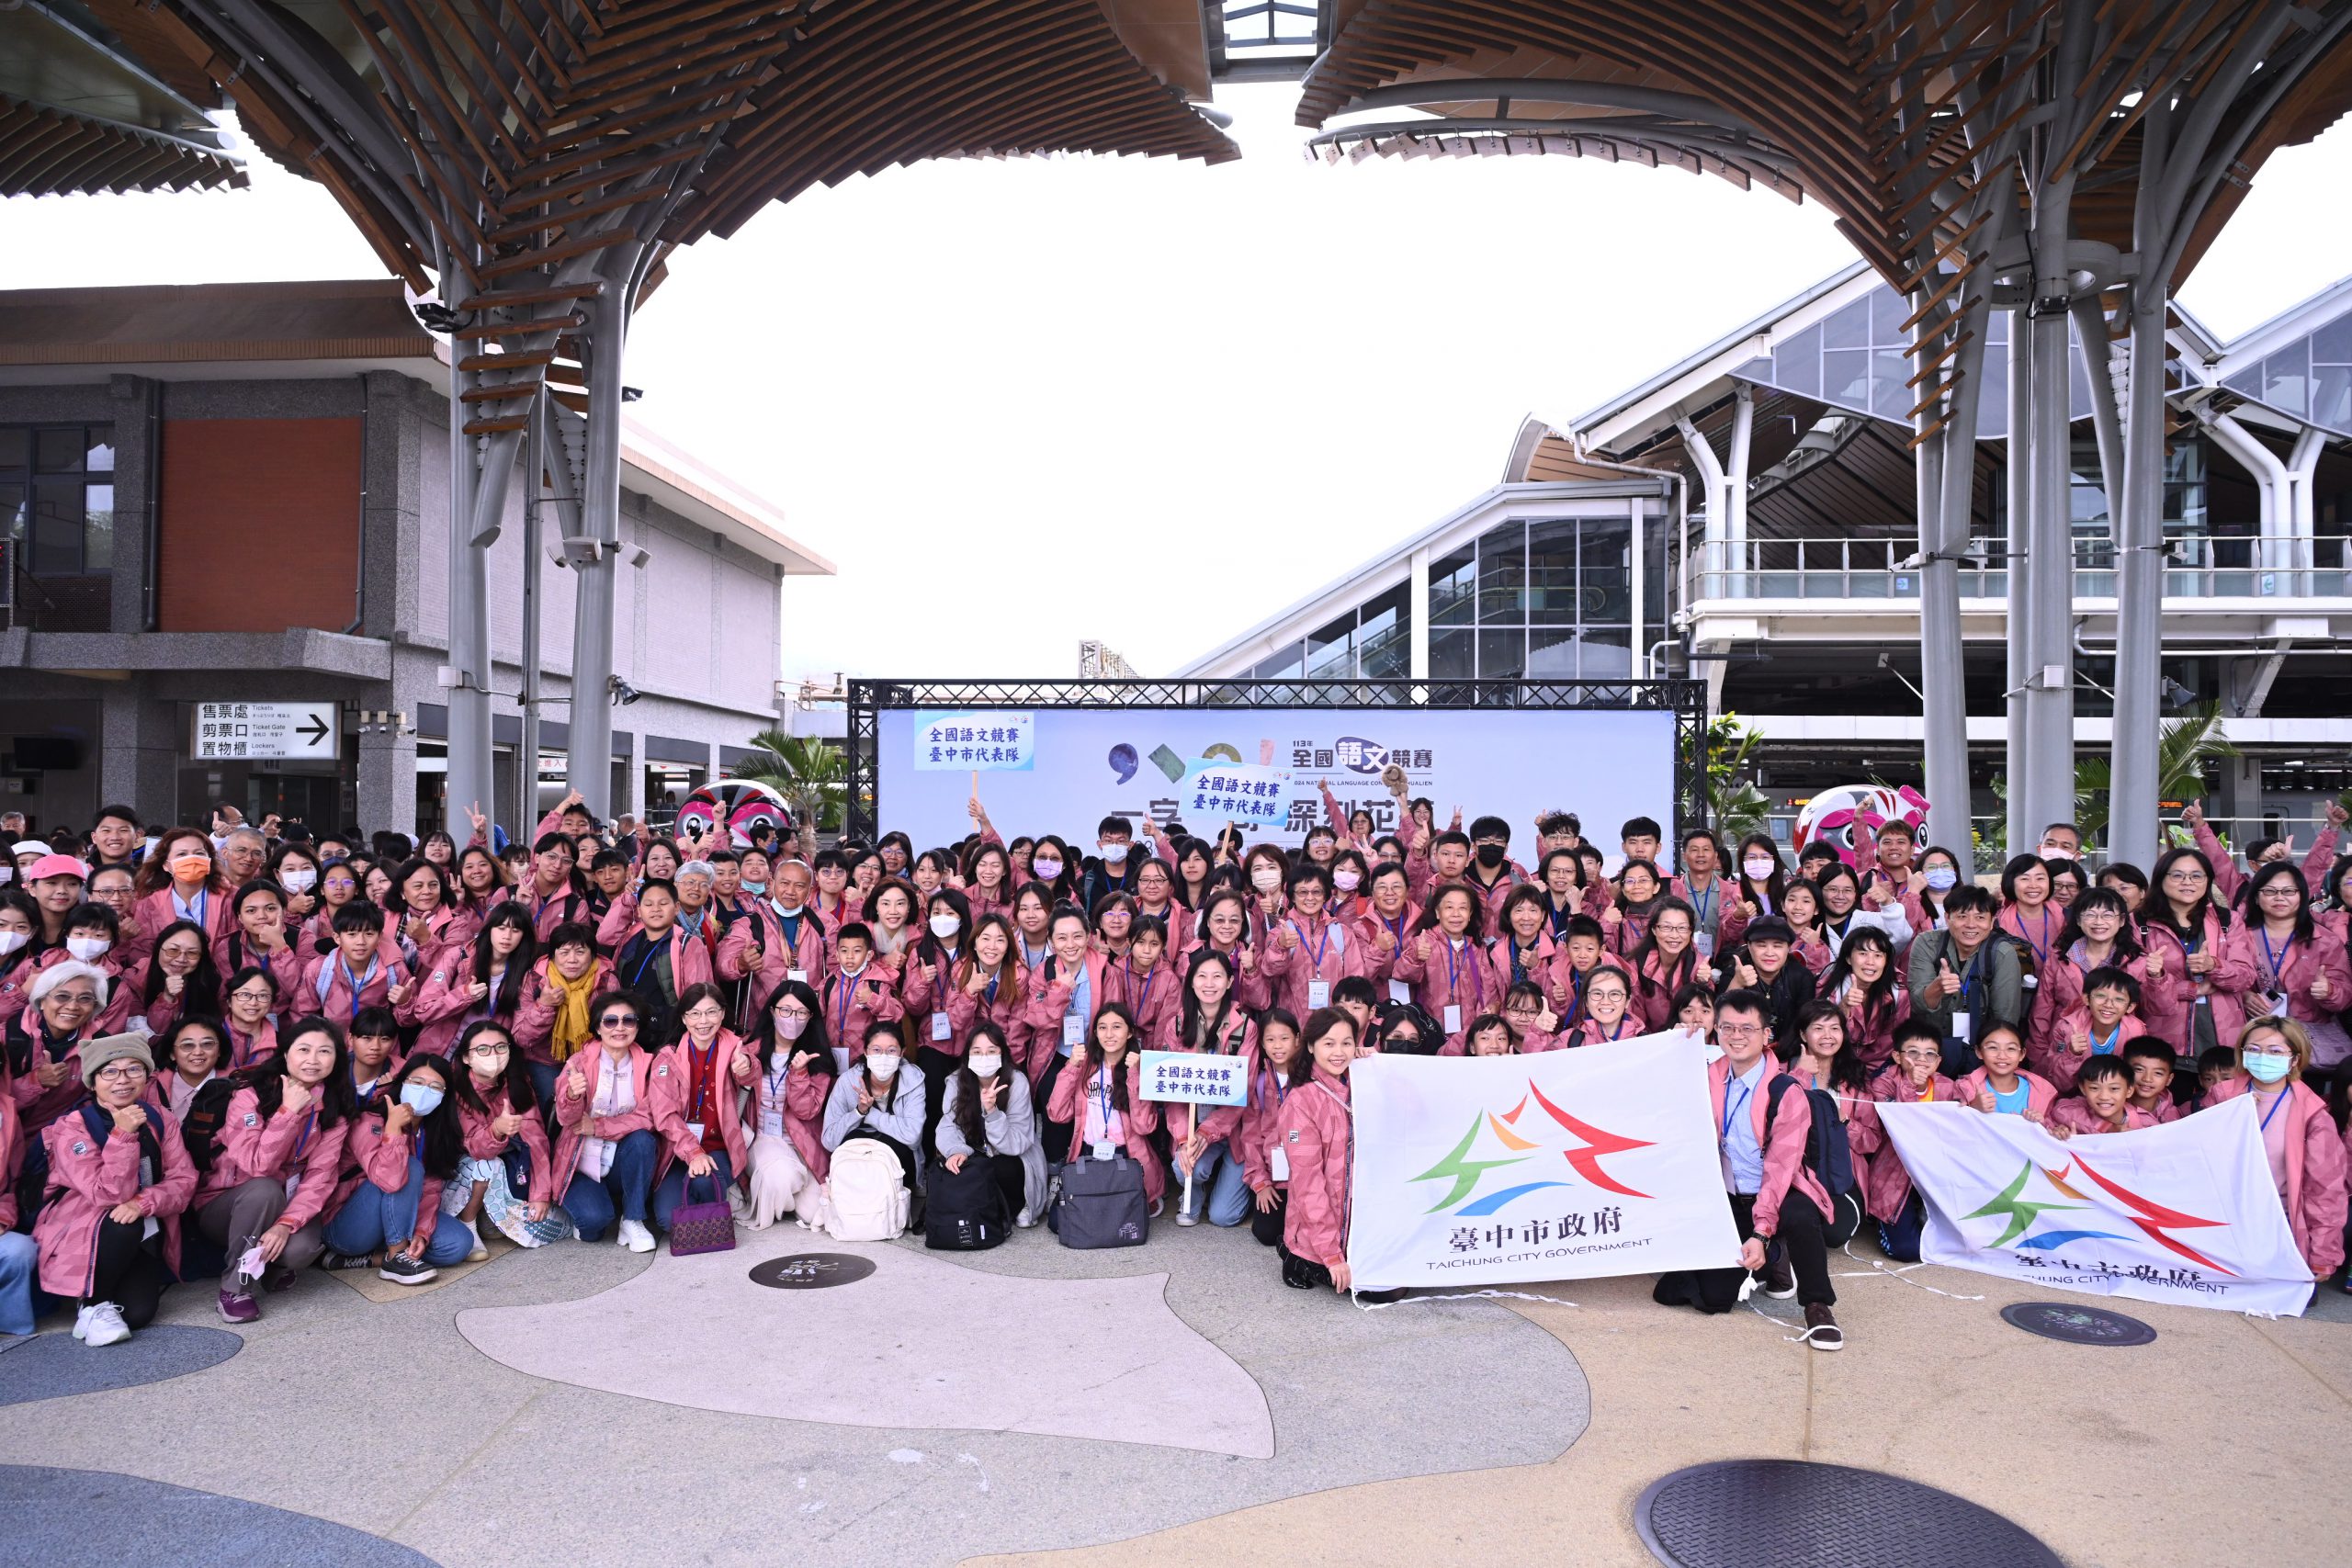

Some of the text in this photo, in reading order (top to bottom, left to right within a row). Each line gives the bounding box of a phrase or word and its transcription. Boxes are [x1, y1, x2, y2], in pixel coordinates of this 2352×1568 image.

[202, 704, 248, 719] 售票處
[202, 723, 248, 738] 剪票口
[929, 727, 1020, 742] 全國語文競賽
[202, 741, 247, 756] 置物櫃
[929, 746, 1020, 762] 臺中市代表隊
[1197, 774, 1280, 797] 全國語文競賽
[1193, 795, 1276, 817] 臺中市代表隊
[1156, 1066, 1231, 1081] 全國語文競賽
[1155, 1080, 1231, 1097] 臺中市代表隊
[1449, 1206, 1623, 1254] 臺中市政府
[1427, 1237, 1653, 1269] TAICHUNG CITY GOVERNMENT
[2078, 1275, 2111, 1283] CITY
